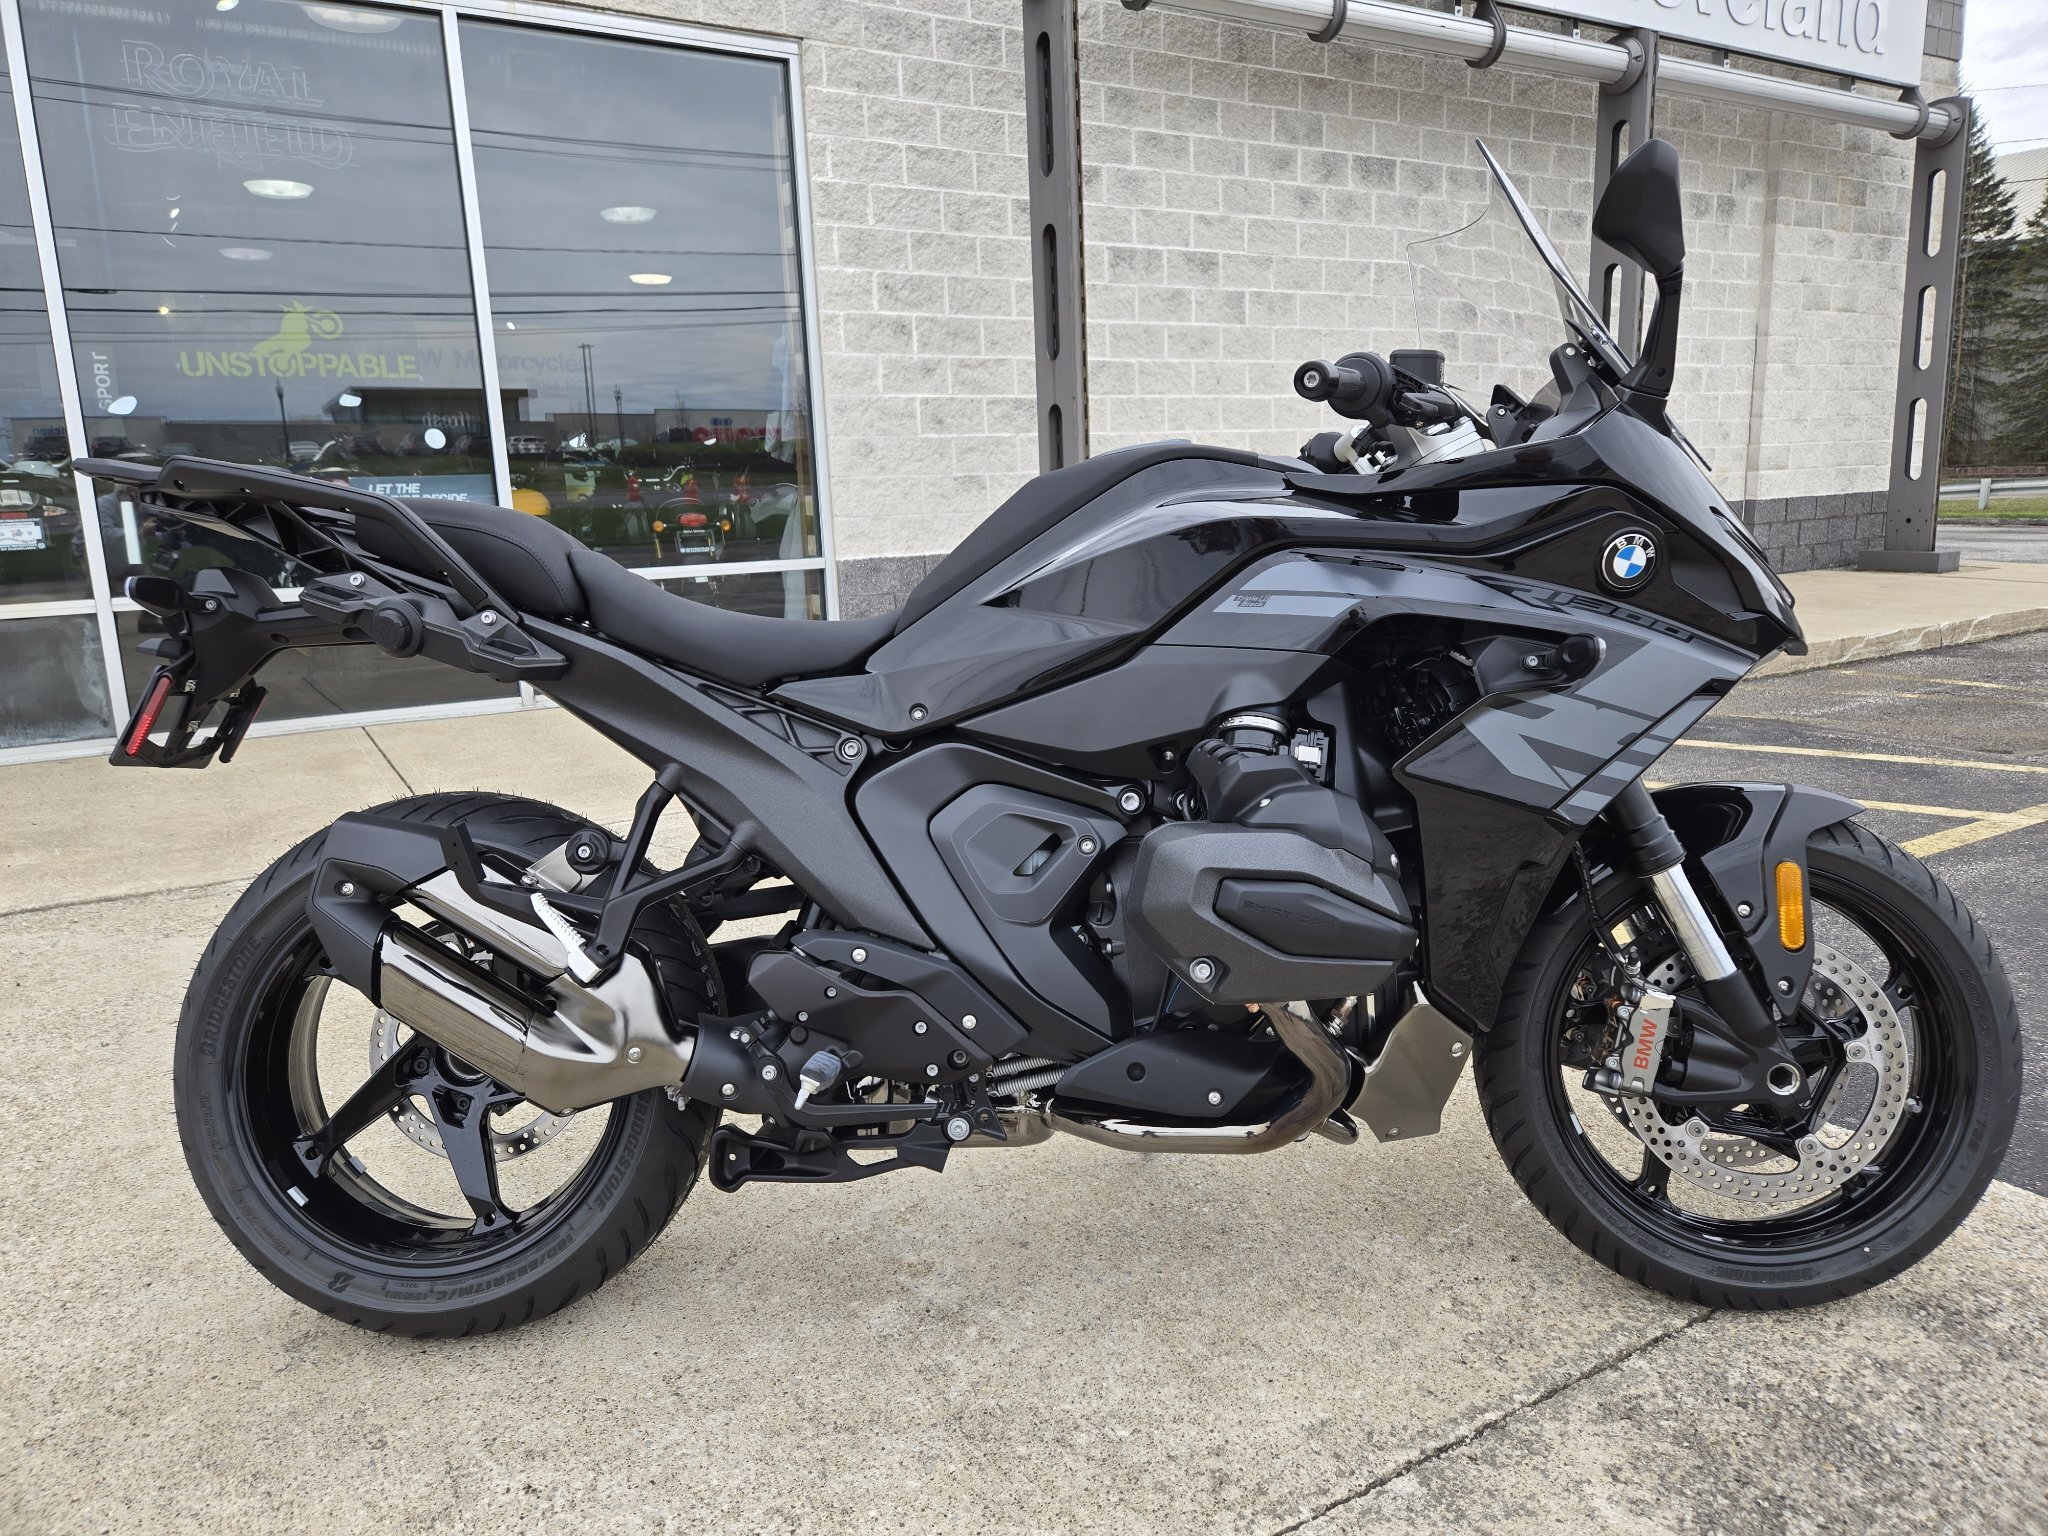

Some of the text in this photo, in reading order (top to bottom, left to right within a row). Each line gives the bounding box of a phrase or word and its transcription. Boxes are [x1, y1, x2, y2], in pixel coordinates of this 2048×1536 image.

[119, 39, 326, 107] ROYAL
[91, 350, 113, 411] SPORT
[180, 350, 417, 379] UNSTOPPABLE
[368, 482, 421, 495] LET THE
[1616, 536, 1656, 559] BMW
[1632, 1018, 1658, 1070] BMW
